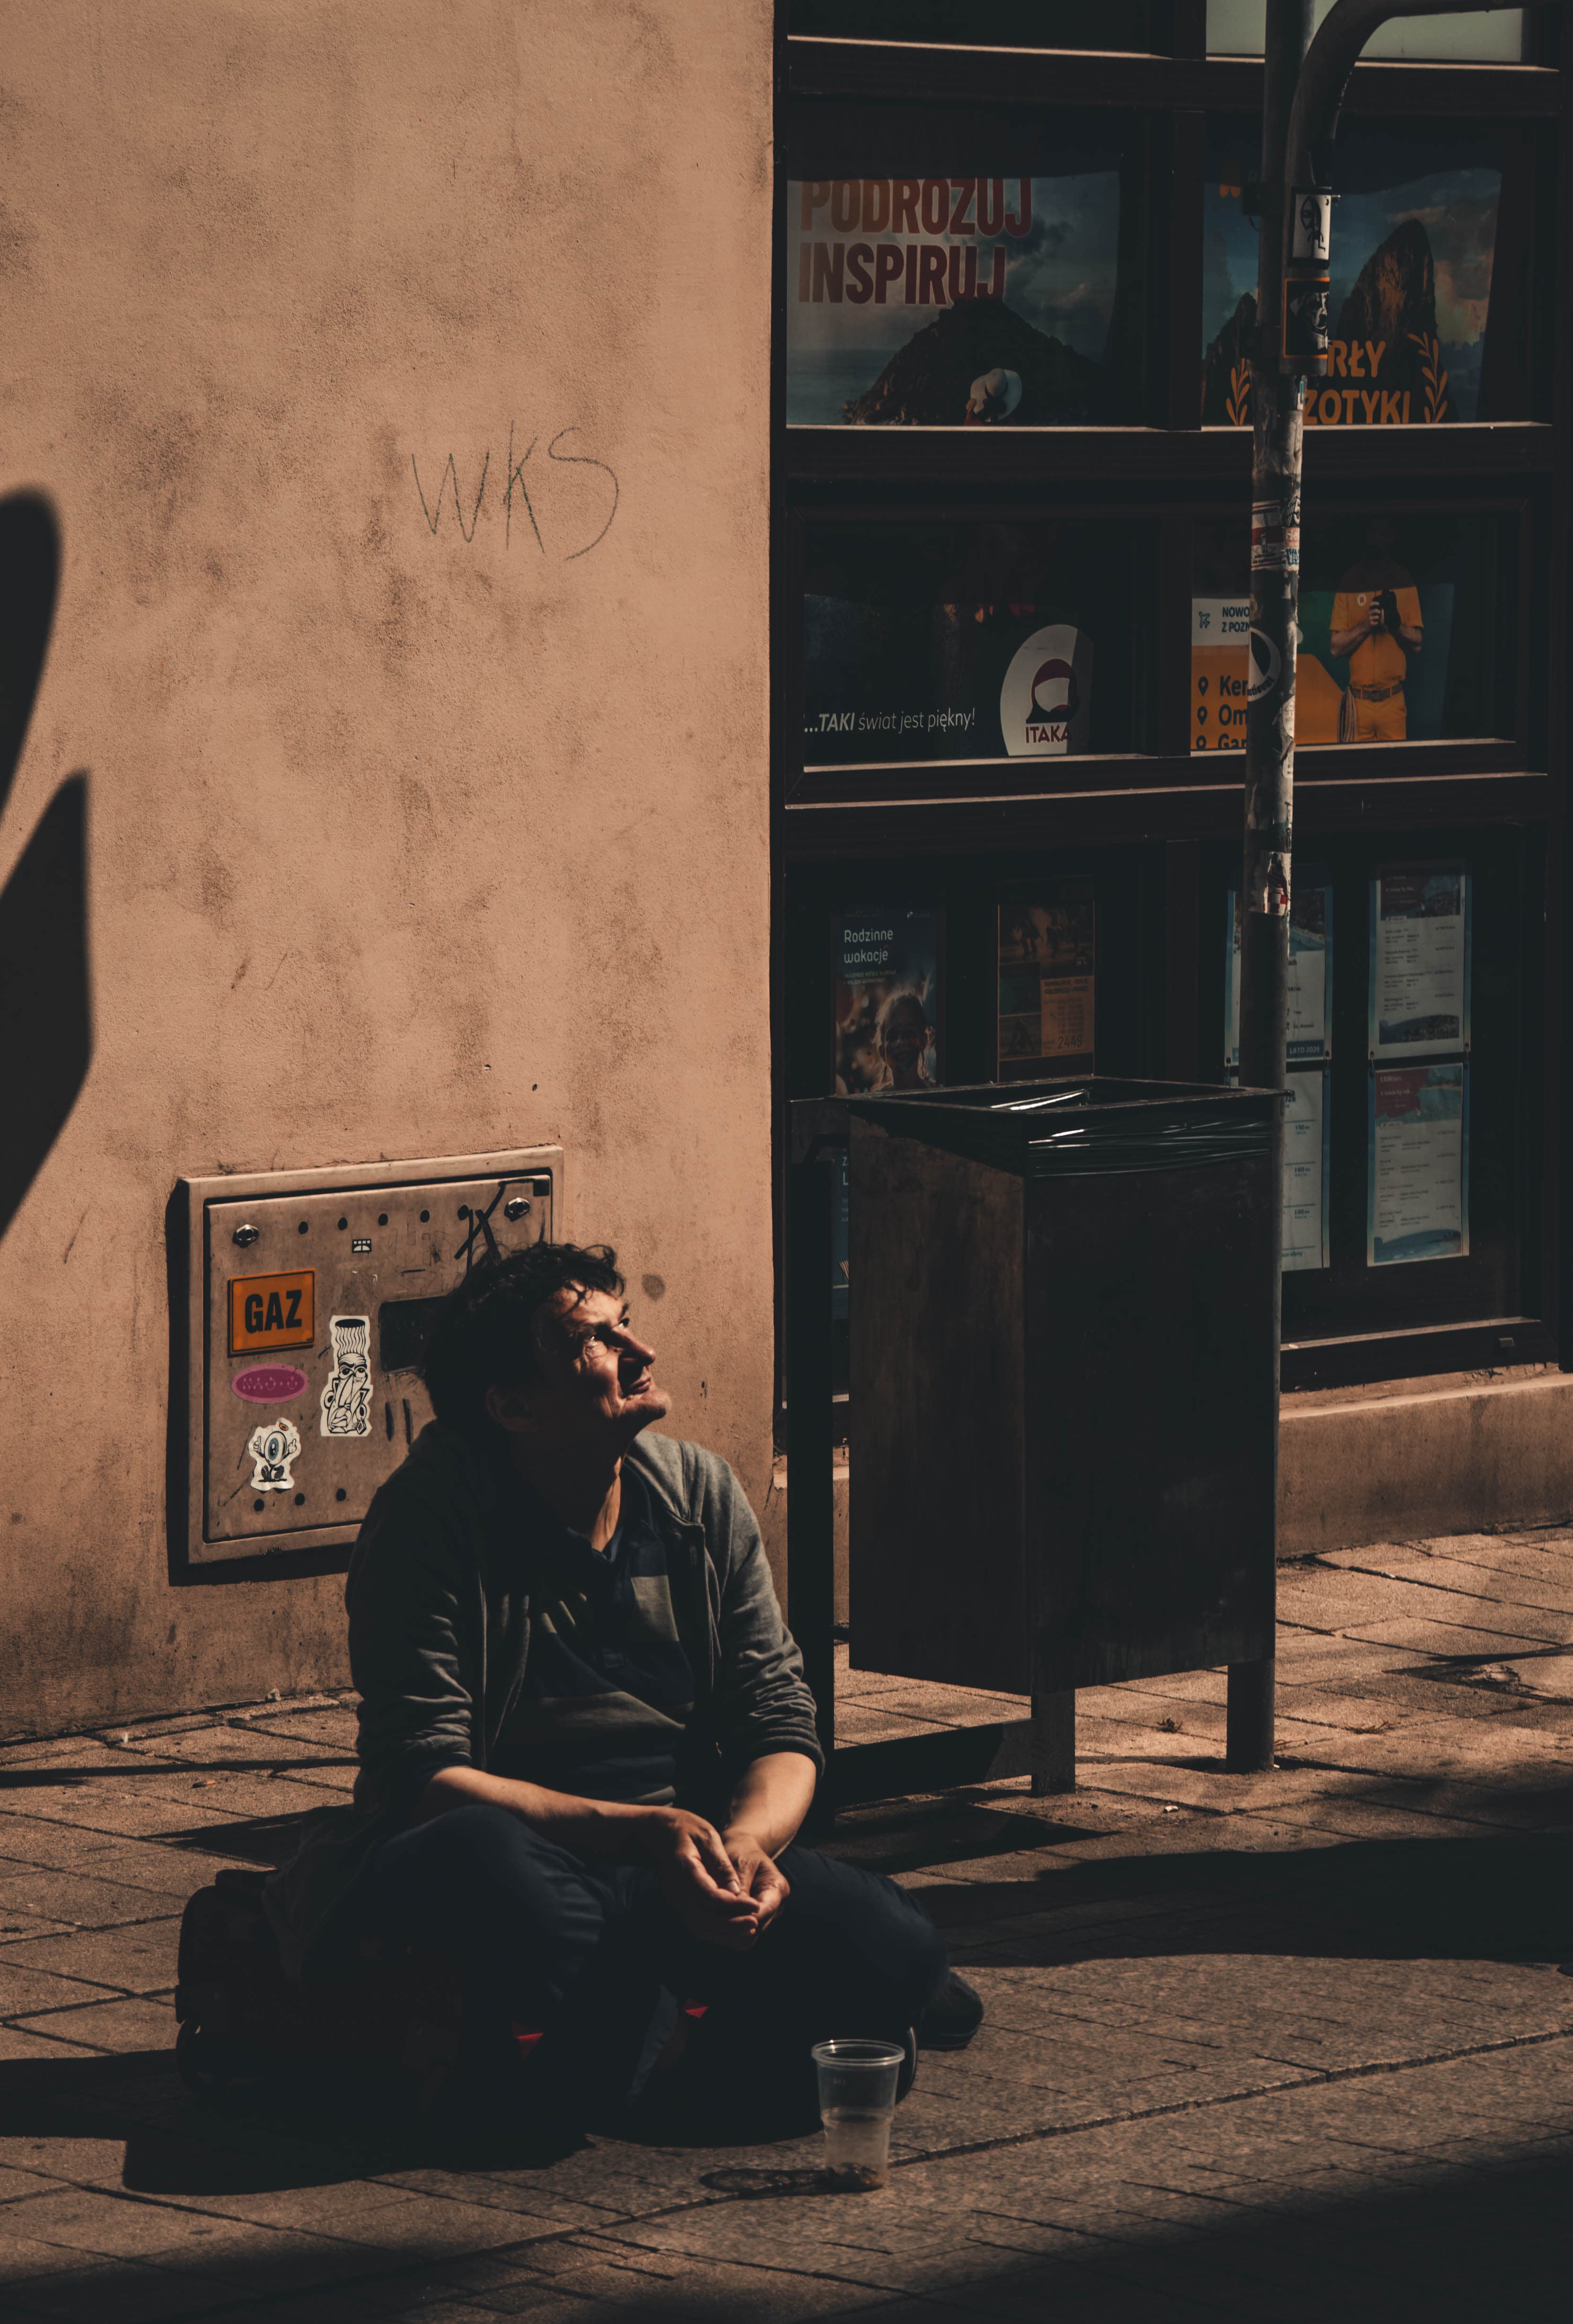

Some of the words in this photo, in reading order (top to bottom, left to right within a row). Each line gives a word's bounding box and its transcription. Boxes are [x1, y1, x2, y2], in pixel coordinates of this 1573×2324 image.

[799, 242, 1006, 304] INSPIRUJ
[1327, 340, 1387, 377] RŁY
[1303, 389, 1411, 424] ZOTYKI
[411, 420, 619, 561] WKS
[1222, 606, 1250, 618] NOWO
[1221, 621, 1227, 633] Z
[1229, 621, 1249, 633] POZN
[804, 712, 855, 733] ...TAKI
[858, 711, 897, 731] świat
[898, 711, 924, 734] jest
[927, 707, 975, 733] piękny!
[1219, 704, 1248, 725] Om
[1026, 725, 1072, 743] ITAKA
[844, 927, 894, 944] Rodzinne
[844, 947, 889, 965] wakacje
[1057, 1033, 1083, 1049] 2449
[1289, 1046, 1305, 1055] LATO
[1306, 1045, 1320, 1053] 2026
[245, 1289, 302, 1334] GAZ
